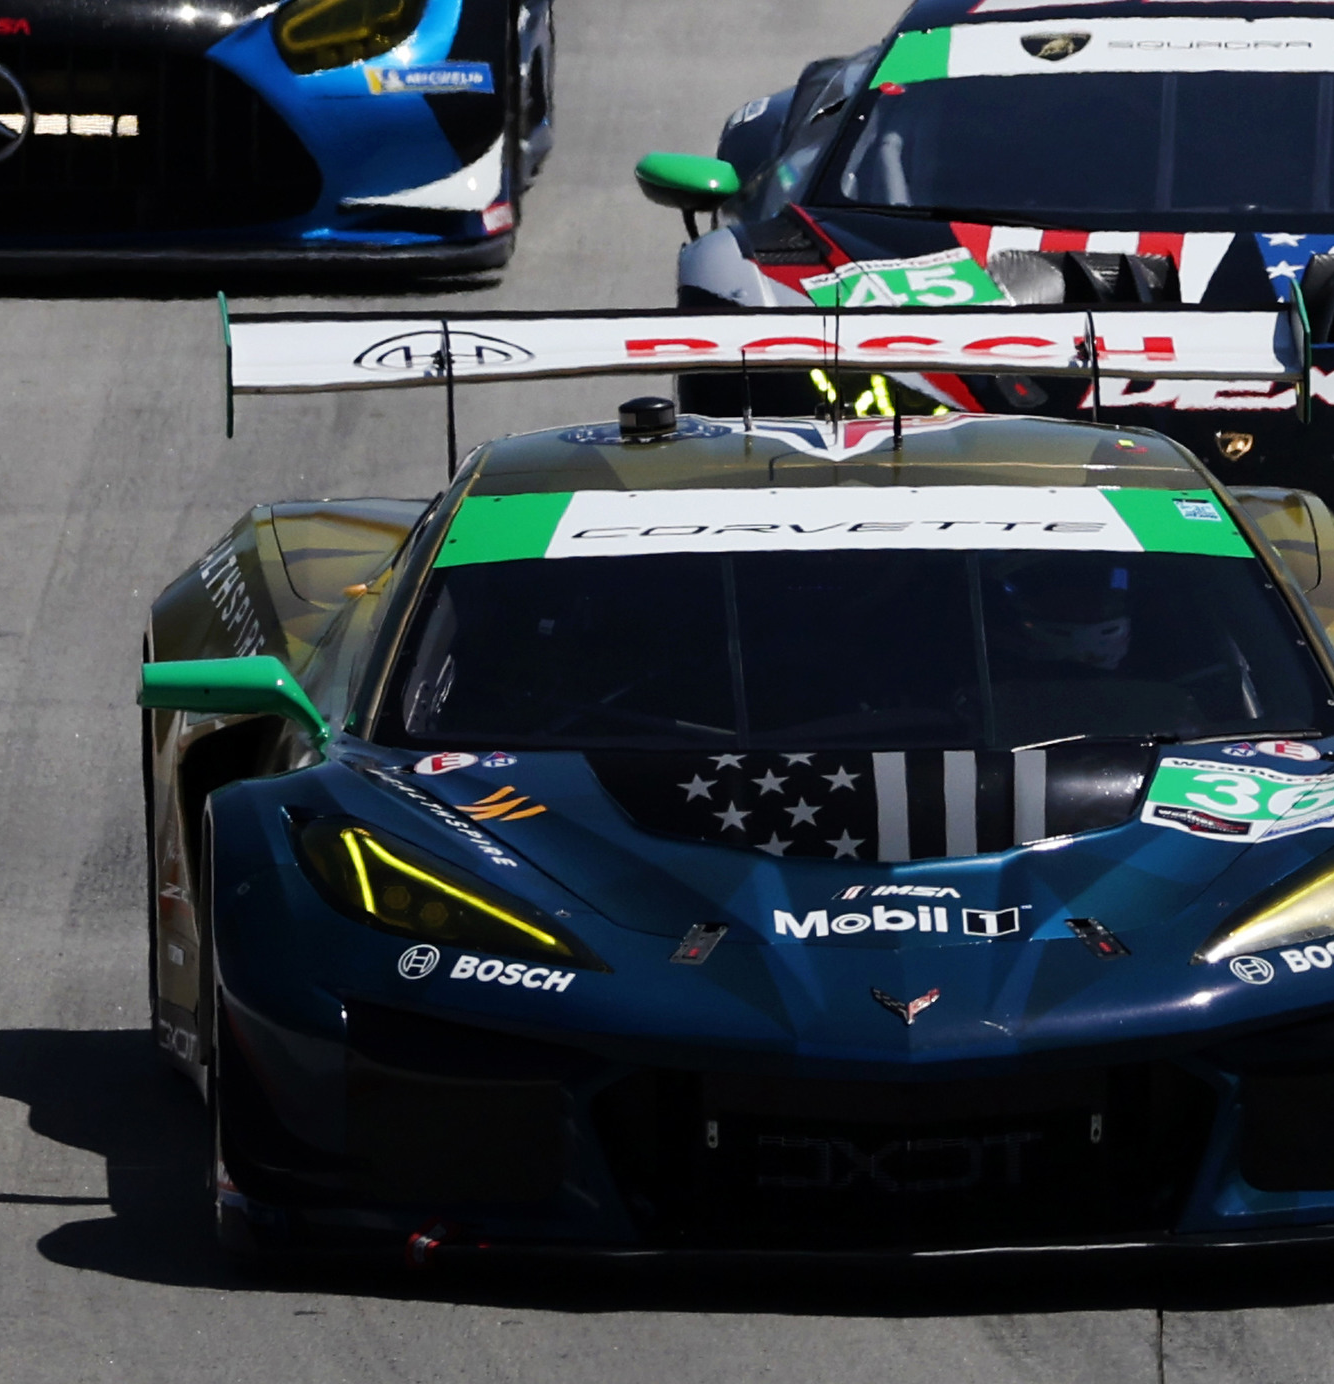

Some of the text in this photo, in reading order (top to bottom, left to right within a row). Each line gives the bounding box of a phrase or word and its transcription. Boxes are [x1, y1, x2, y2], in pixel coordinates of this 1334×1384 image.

[1109, 40, 1314, 53] SQUADRA
[405, 69, 484, 86] MICHELIN
[845, 267, 974, 307] 45
[571, 519, 1107, 540] CORVETTE
[872, 885, 961, 898] IMSA
[774, 905, 948, 938] Mobil
[450, 955, 576, 993] BOSCH
